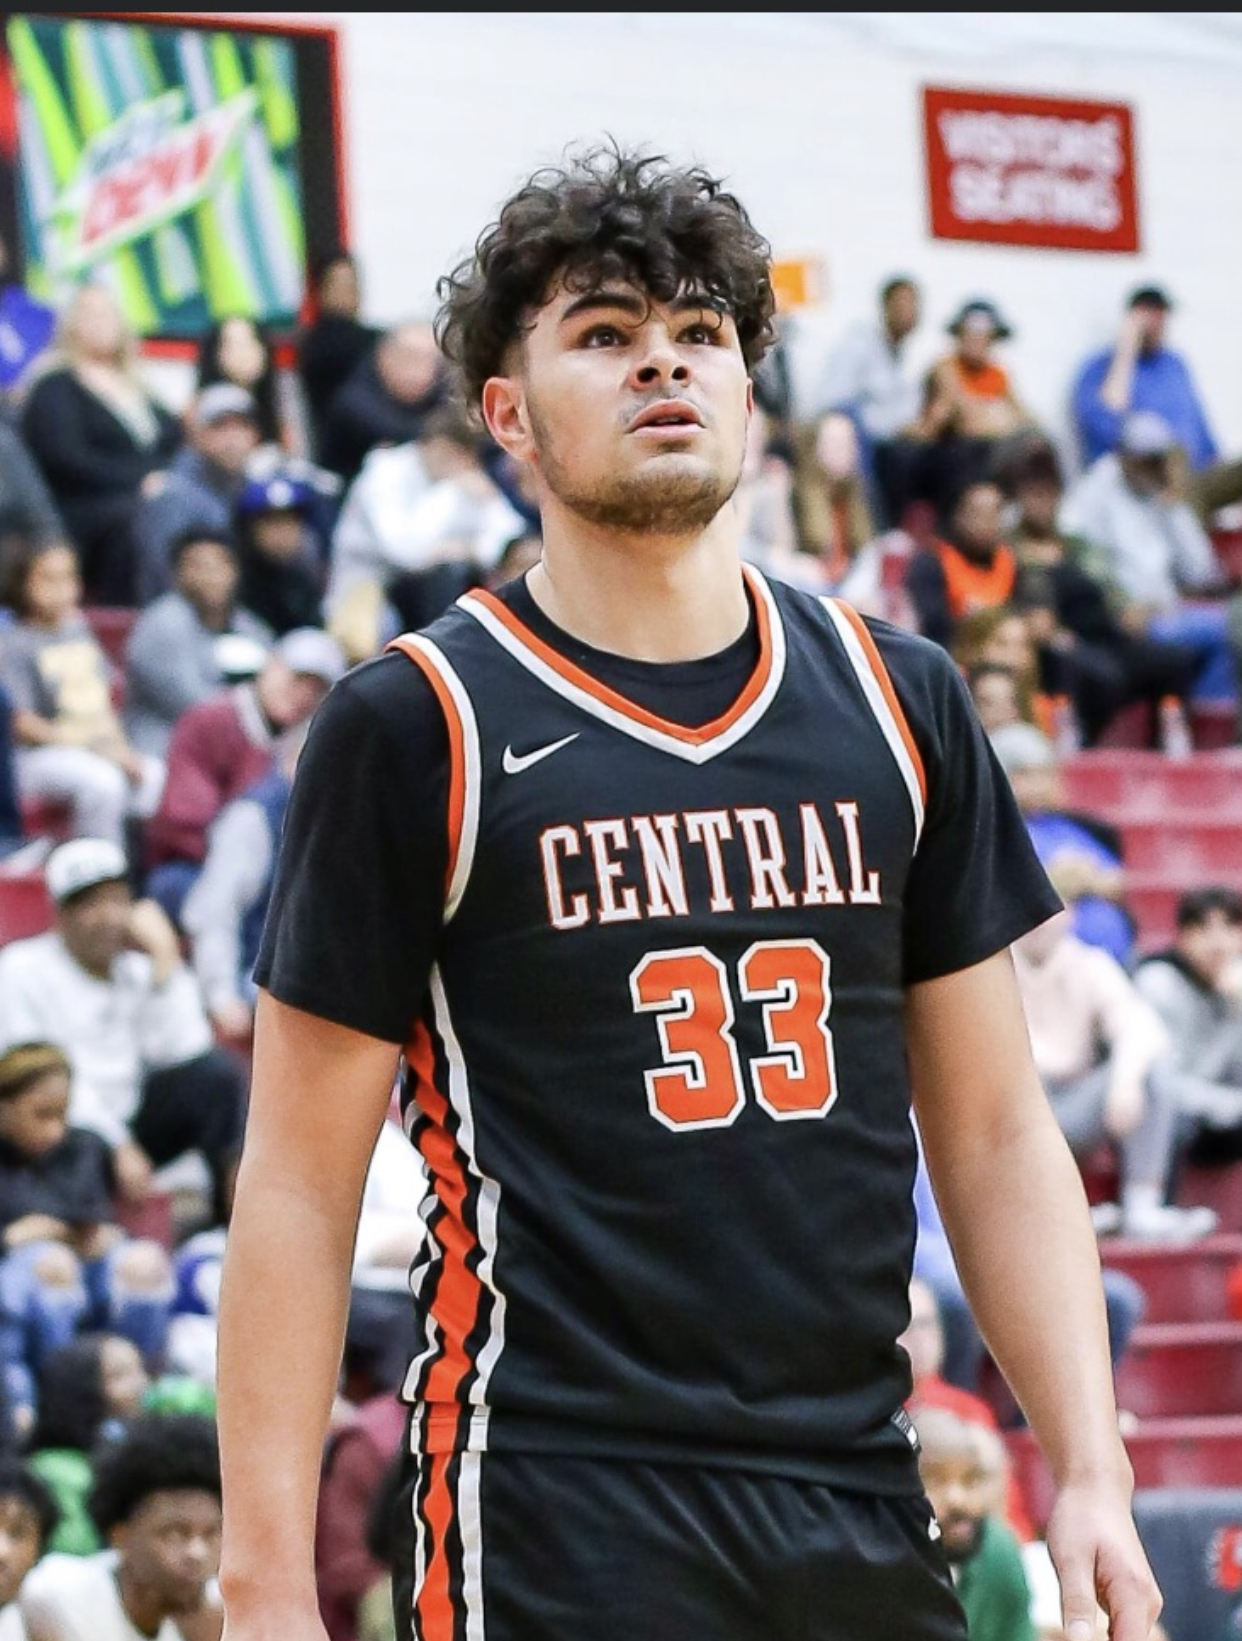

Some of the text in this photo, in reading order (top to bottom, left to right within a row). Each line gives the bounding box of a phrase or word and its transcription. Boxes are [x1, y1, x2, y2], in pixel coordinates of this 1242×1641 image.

[949, 163, 1122, 232] SEATING
[540, 801, 881, 930] CENTRAL
[629, 938, 838, 1132] 33
